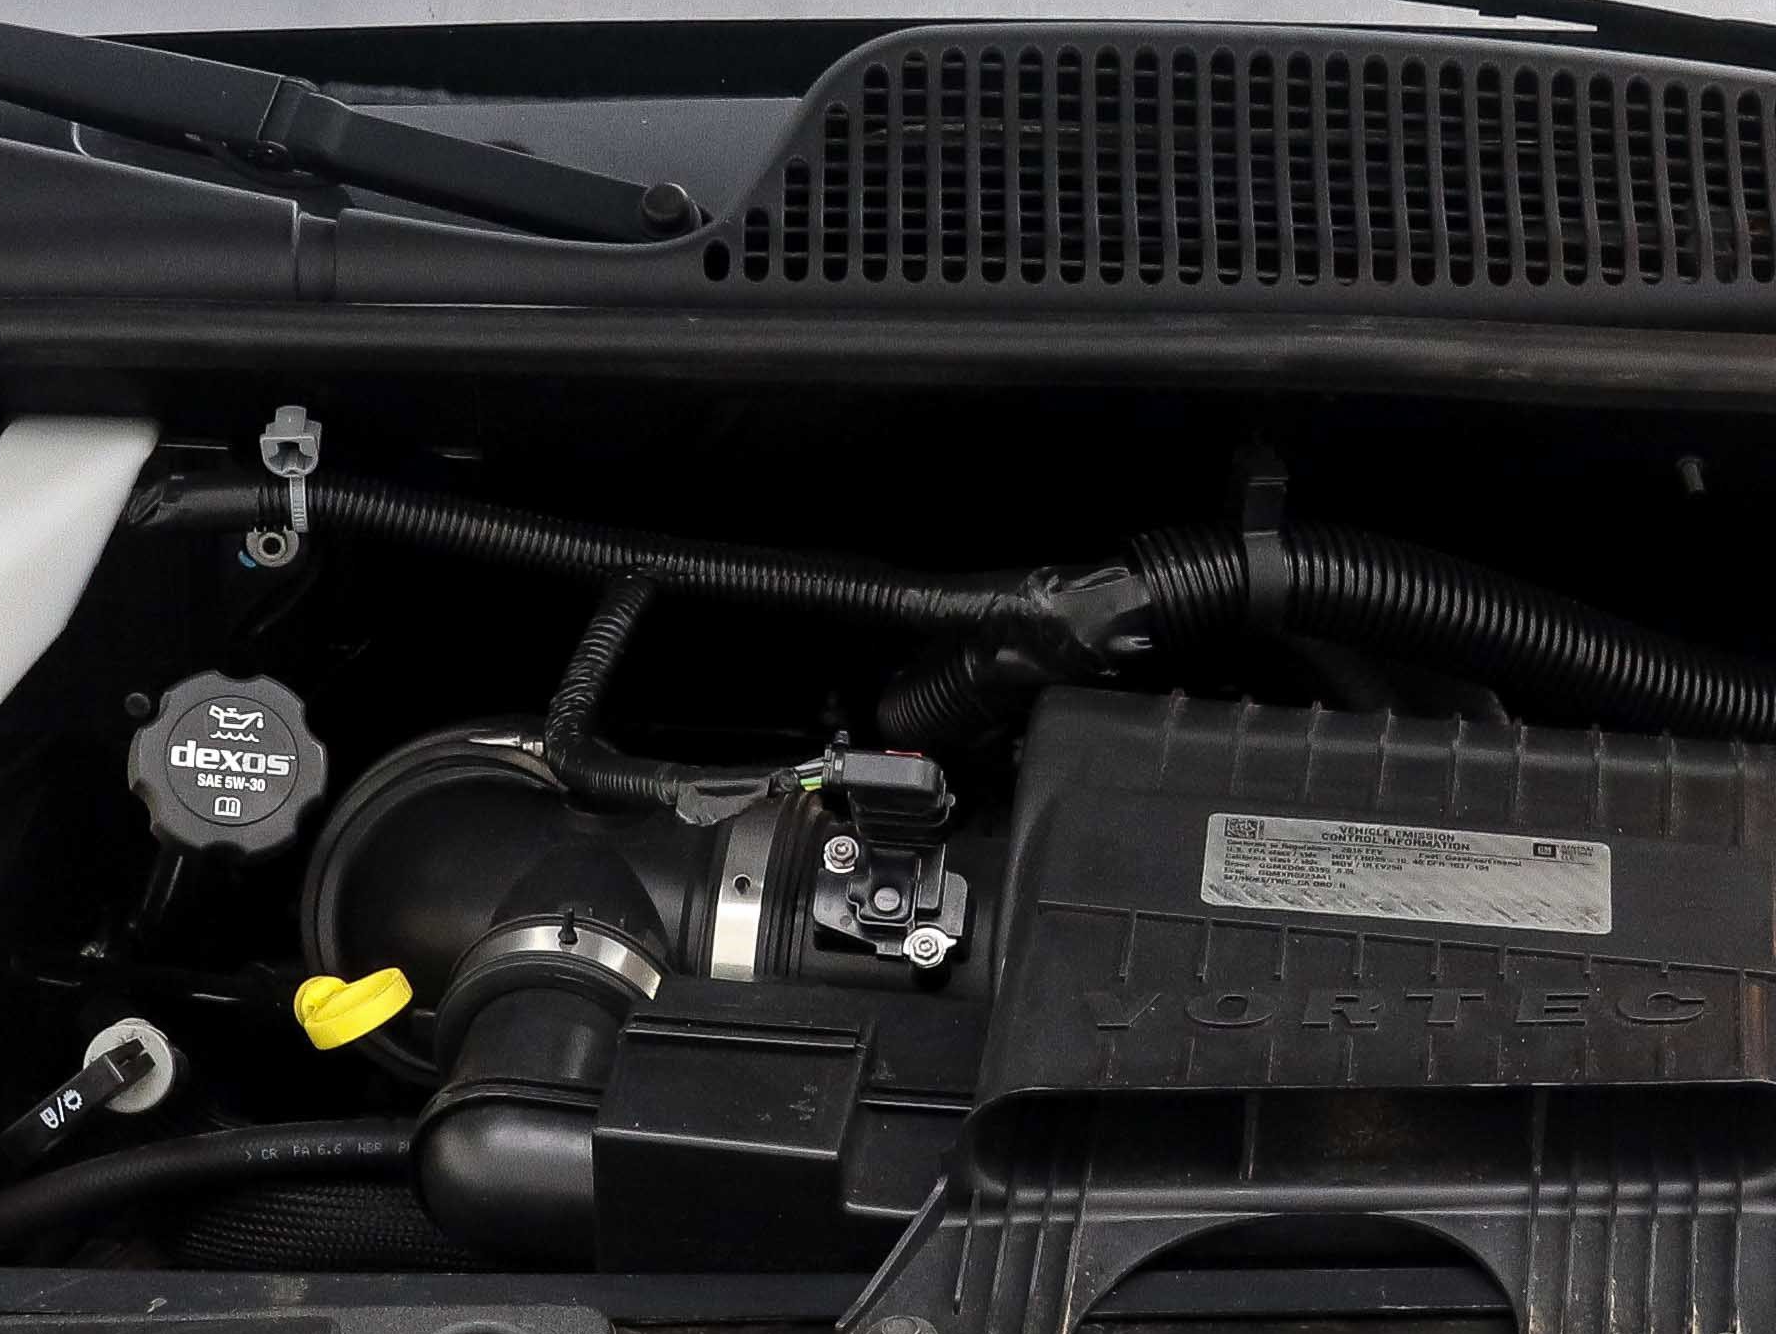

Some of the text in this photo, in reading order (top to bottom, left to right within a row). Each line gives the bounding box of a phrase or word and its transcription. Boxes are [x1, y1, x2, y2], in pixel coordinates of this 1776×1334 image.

[169, 739, 293, 777] dexos
[197, 773, 266, 792] SAE 5W-30
[1321, 833, 1471, 851] CONTROL INFORMATION
[1339, 825, 1455, 842] VEHICLE EMISSION
[1082, 988, 1708, 1031] VORTEC
[261, 1147, 279, 1160] CR
[292, 1144, 310, 1156] PA
[317, 1142, 342, 1155] 6.6
